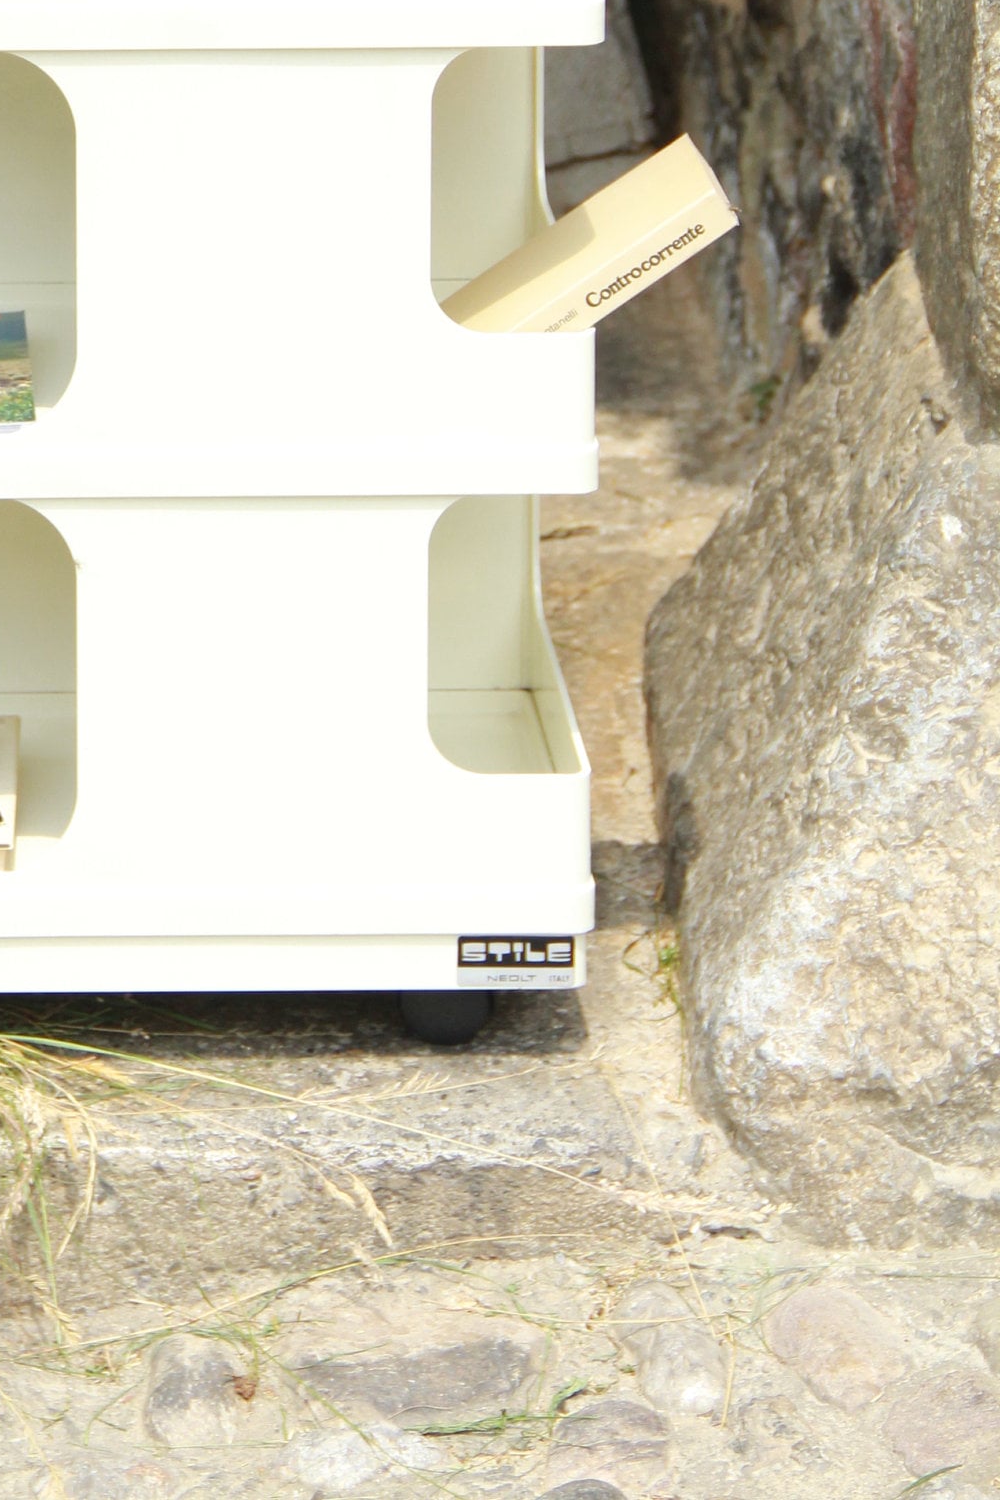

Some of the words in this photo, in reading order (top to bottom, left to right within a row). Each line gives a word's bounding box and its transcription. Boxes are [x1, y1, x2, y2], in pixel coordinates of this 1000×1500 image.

[585, 222, 706, 308] Controcorrente
[461, 942, 571, 962] STILE
[487, 974, 537, 982] NEOLT
